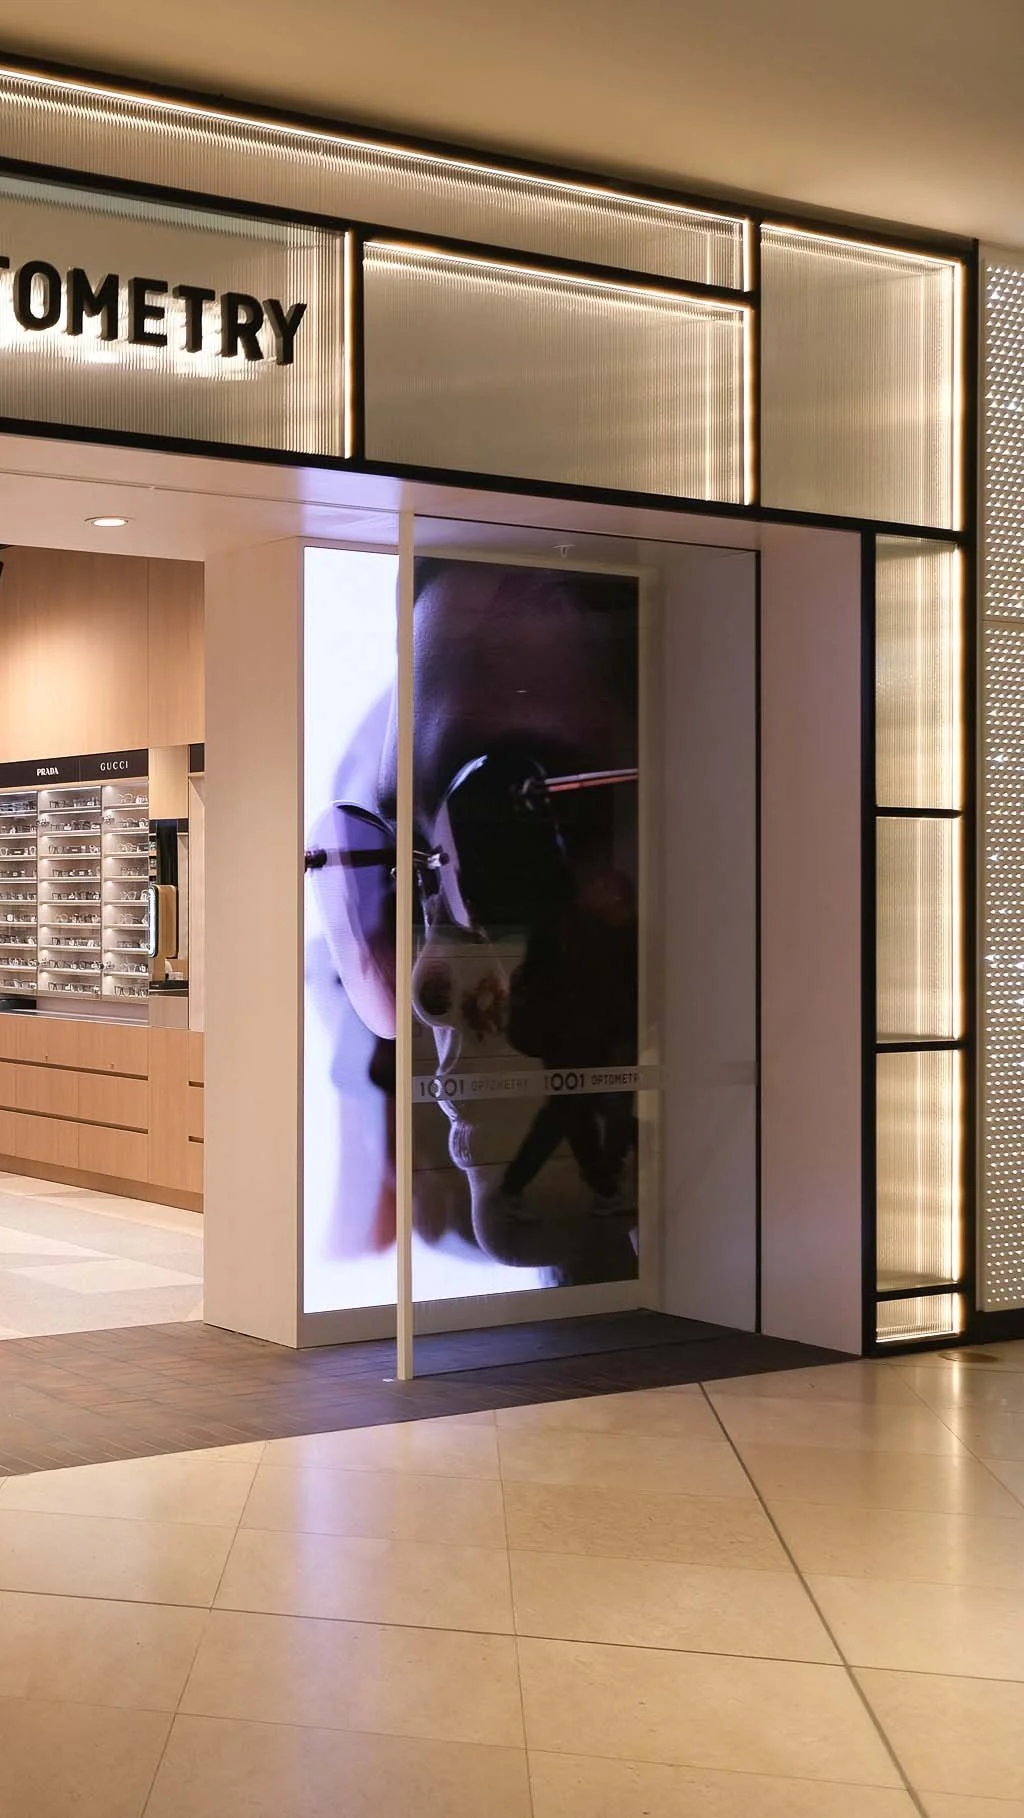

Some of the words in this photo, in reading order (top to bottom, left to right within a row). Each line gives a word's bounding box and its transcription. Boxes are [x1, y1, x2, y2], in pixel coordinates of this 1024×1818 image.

[100, 760, 129, 771] GUCCI
[36, 767, 59, 777] PRADA
[543, 1072, 585, 1091] 1001
[591, 1071, 644, 1086] OPTOMETR
